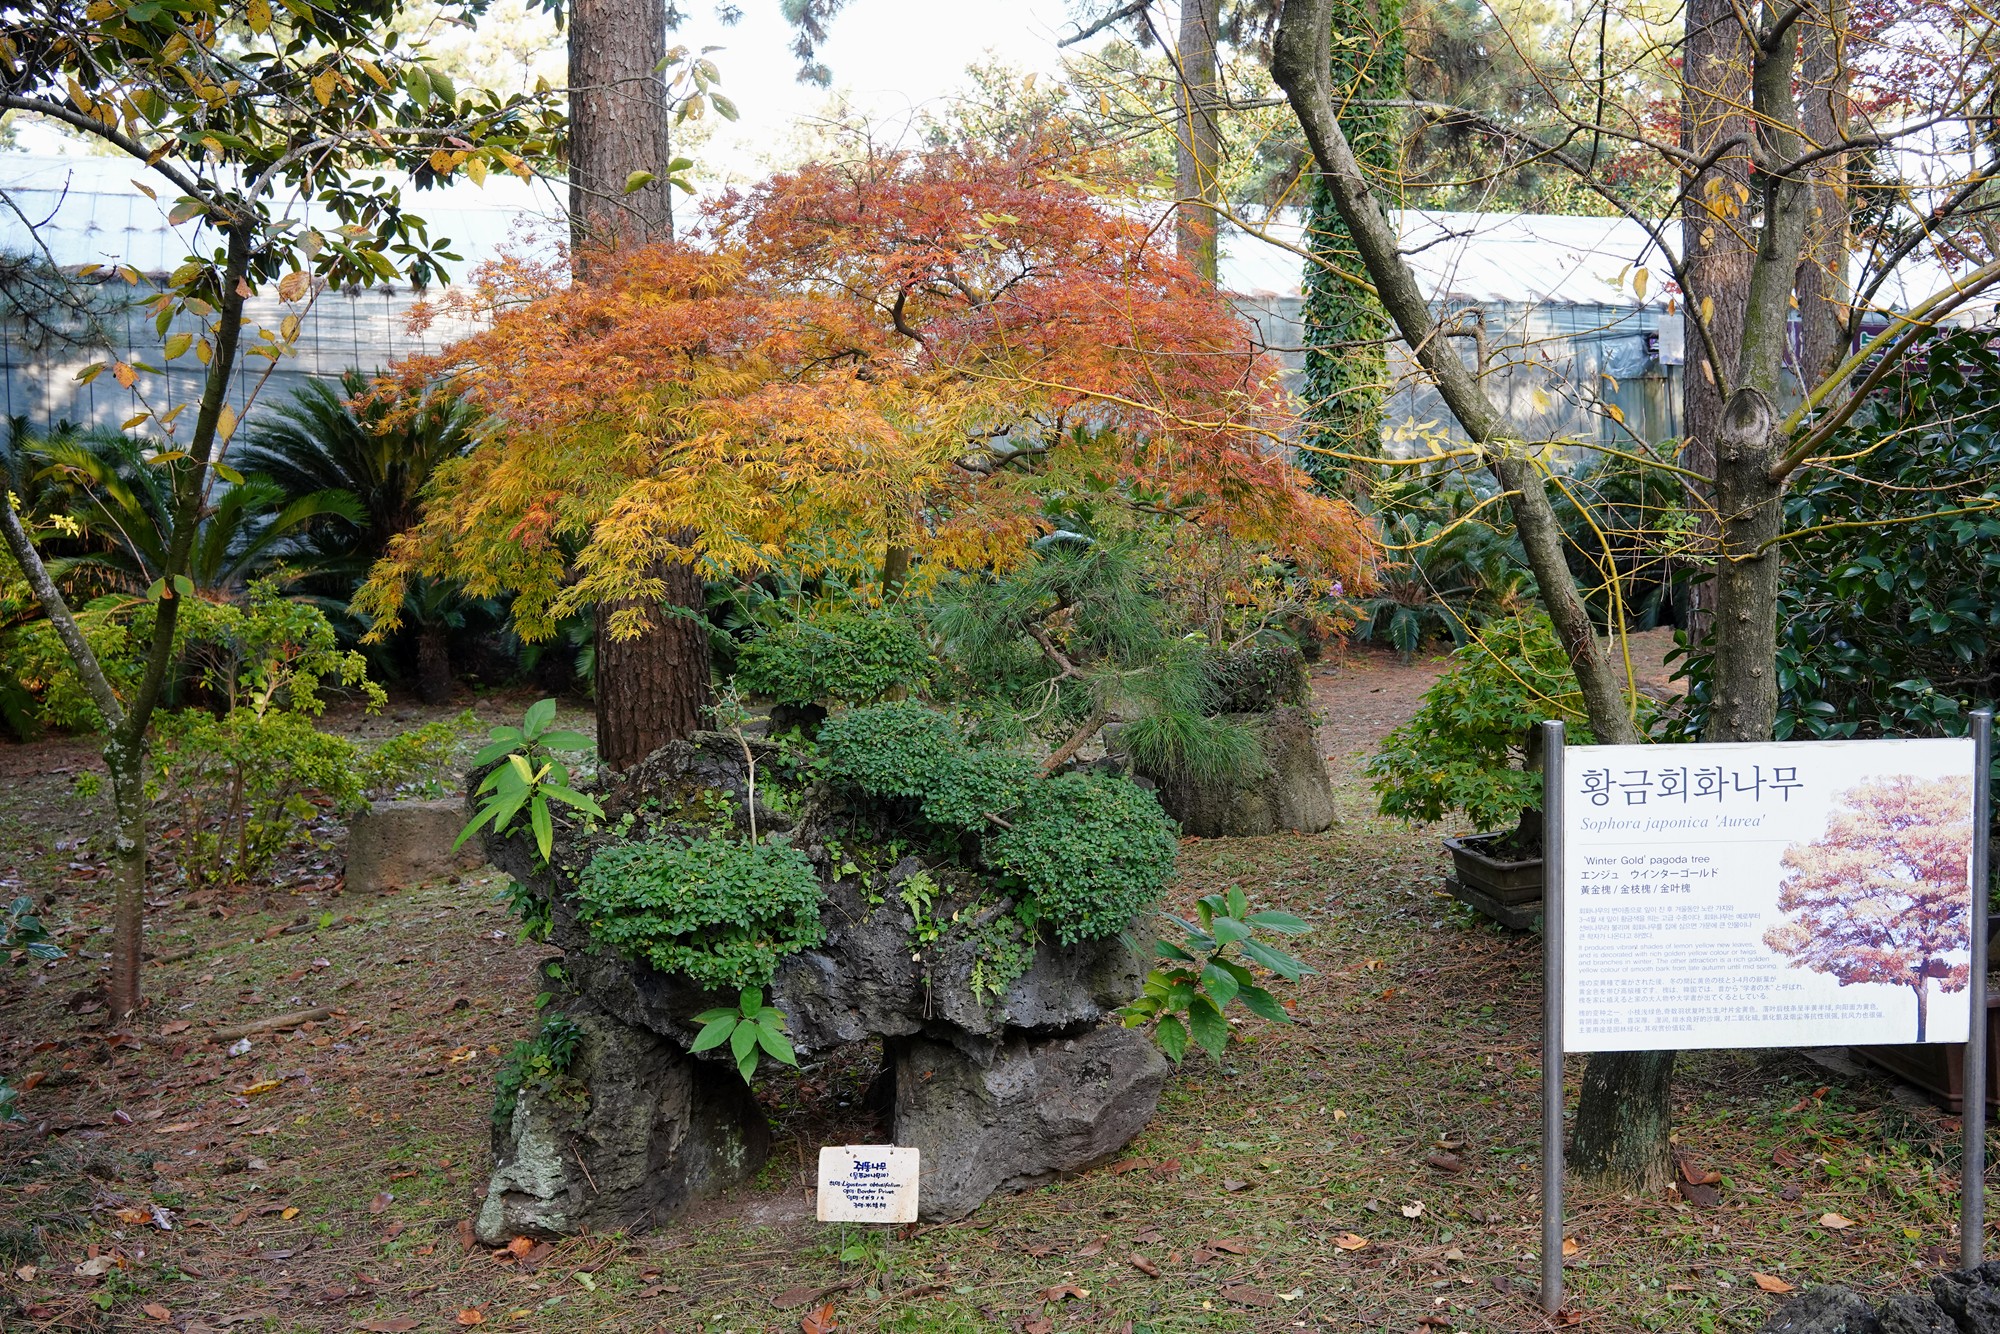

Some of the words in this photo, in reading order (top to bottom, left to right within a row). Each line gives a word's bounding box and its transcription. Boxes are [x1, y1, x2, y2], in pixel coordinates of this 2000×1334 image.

[1580, 765, 1804, 806] 황금회화나무
[1580, 817, 1641, 834] Sophora
[1644, 816, 1709, 832] japonica
[1650, 856, 1688, 865] pagoda
[1581, 870, 1619, 879] エンジュ
